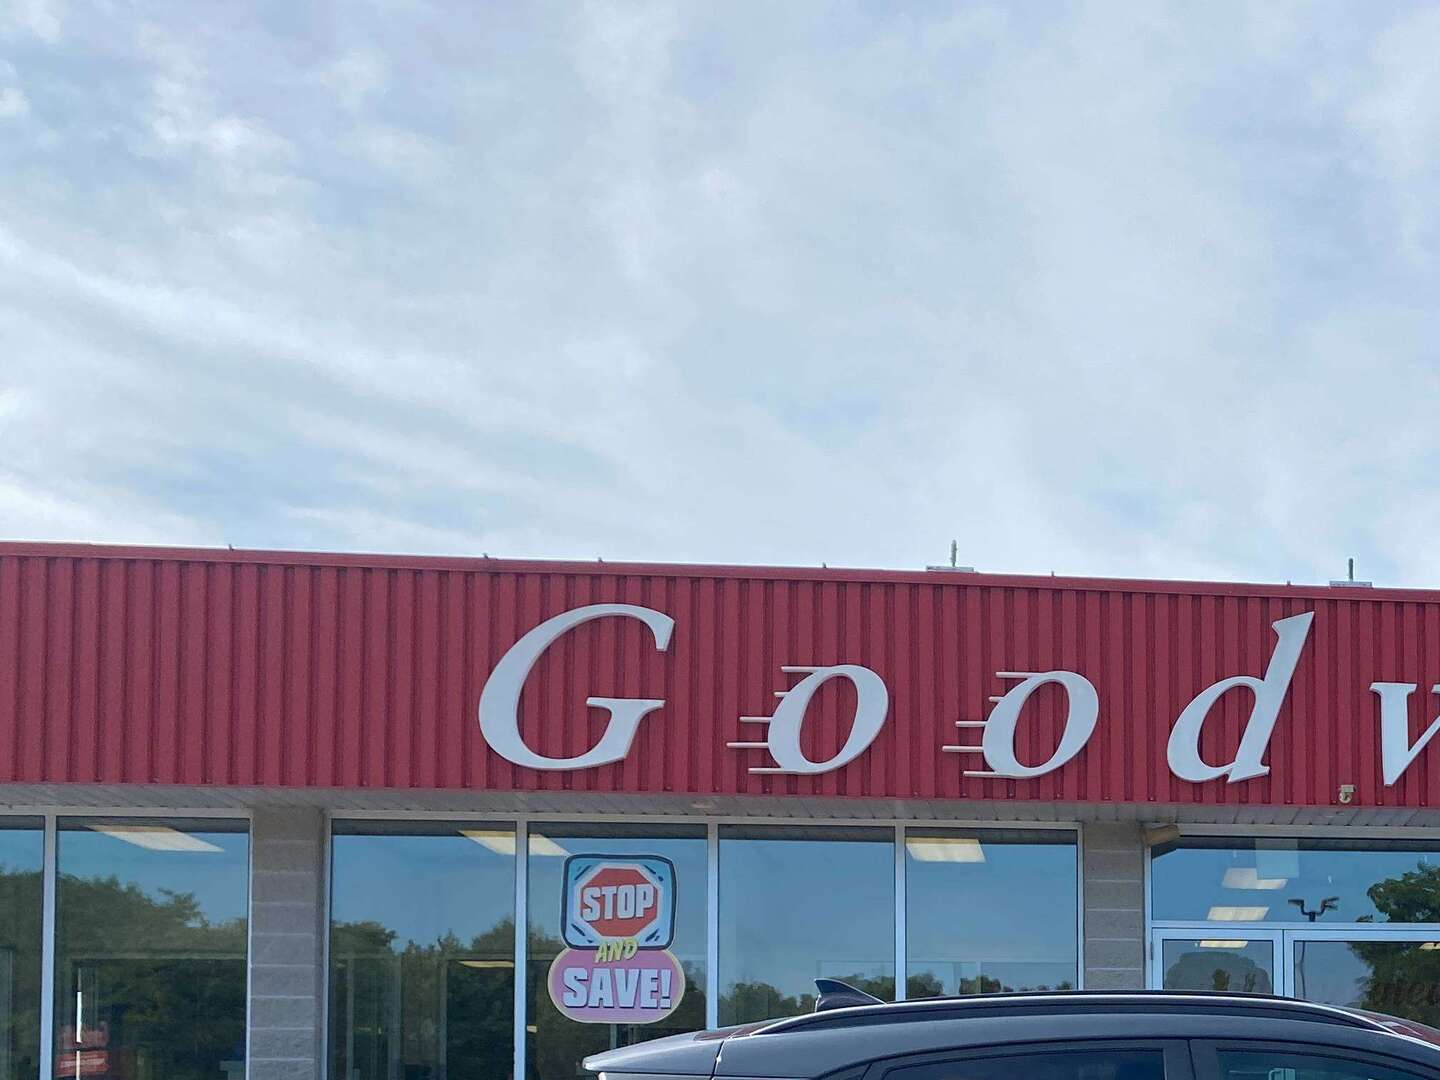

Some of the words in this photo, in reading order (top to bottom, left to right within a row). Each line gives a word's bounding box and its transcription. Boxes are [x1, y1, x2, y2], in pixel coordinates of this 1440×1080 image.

[582, 884, 655, 922] STOP
[594, 938, 639, 963] AND
[563, 967, 672, 1009] SAVE!
